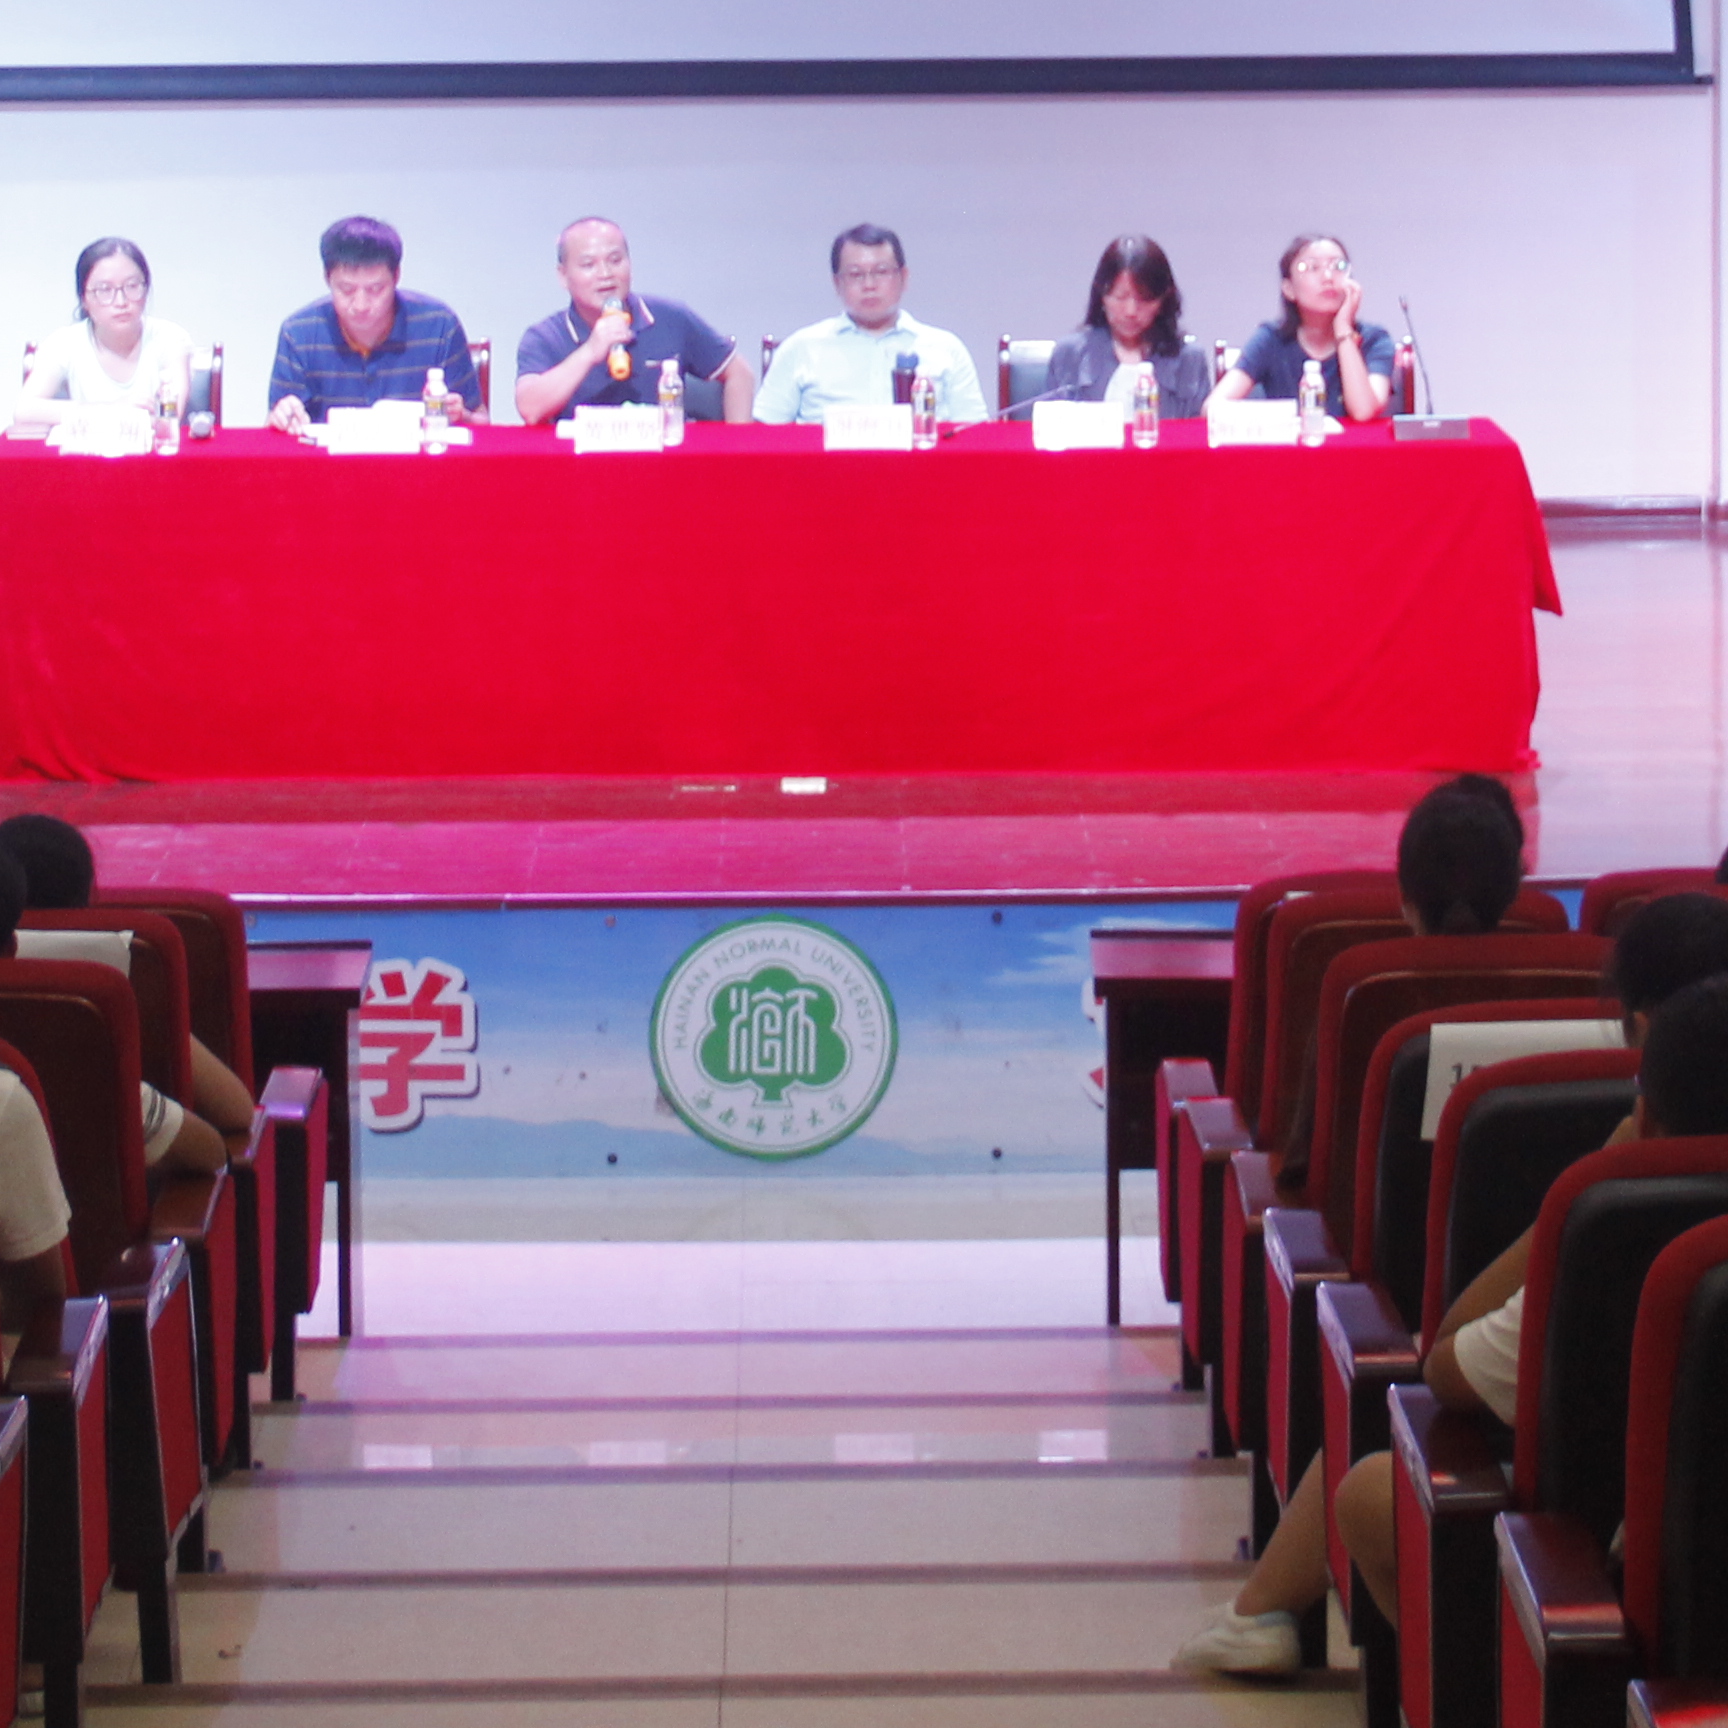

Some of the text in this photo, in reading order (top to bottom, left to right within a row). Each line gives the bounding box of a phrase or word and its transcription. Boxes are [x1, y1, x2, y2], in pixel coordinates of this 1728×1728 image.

[359, 964, 472, 1122] 学
[674, 937, 876, 1053] HAINAN NORMAL UNIVERSITY
